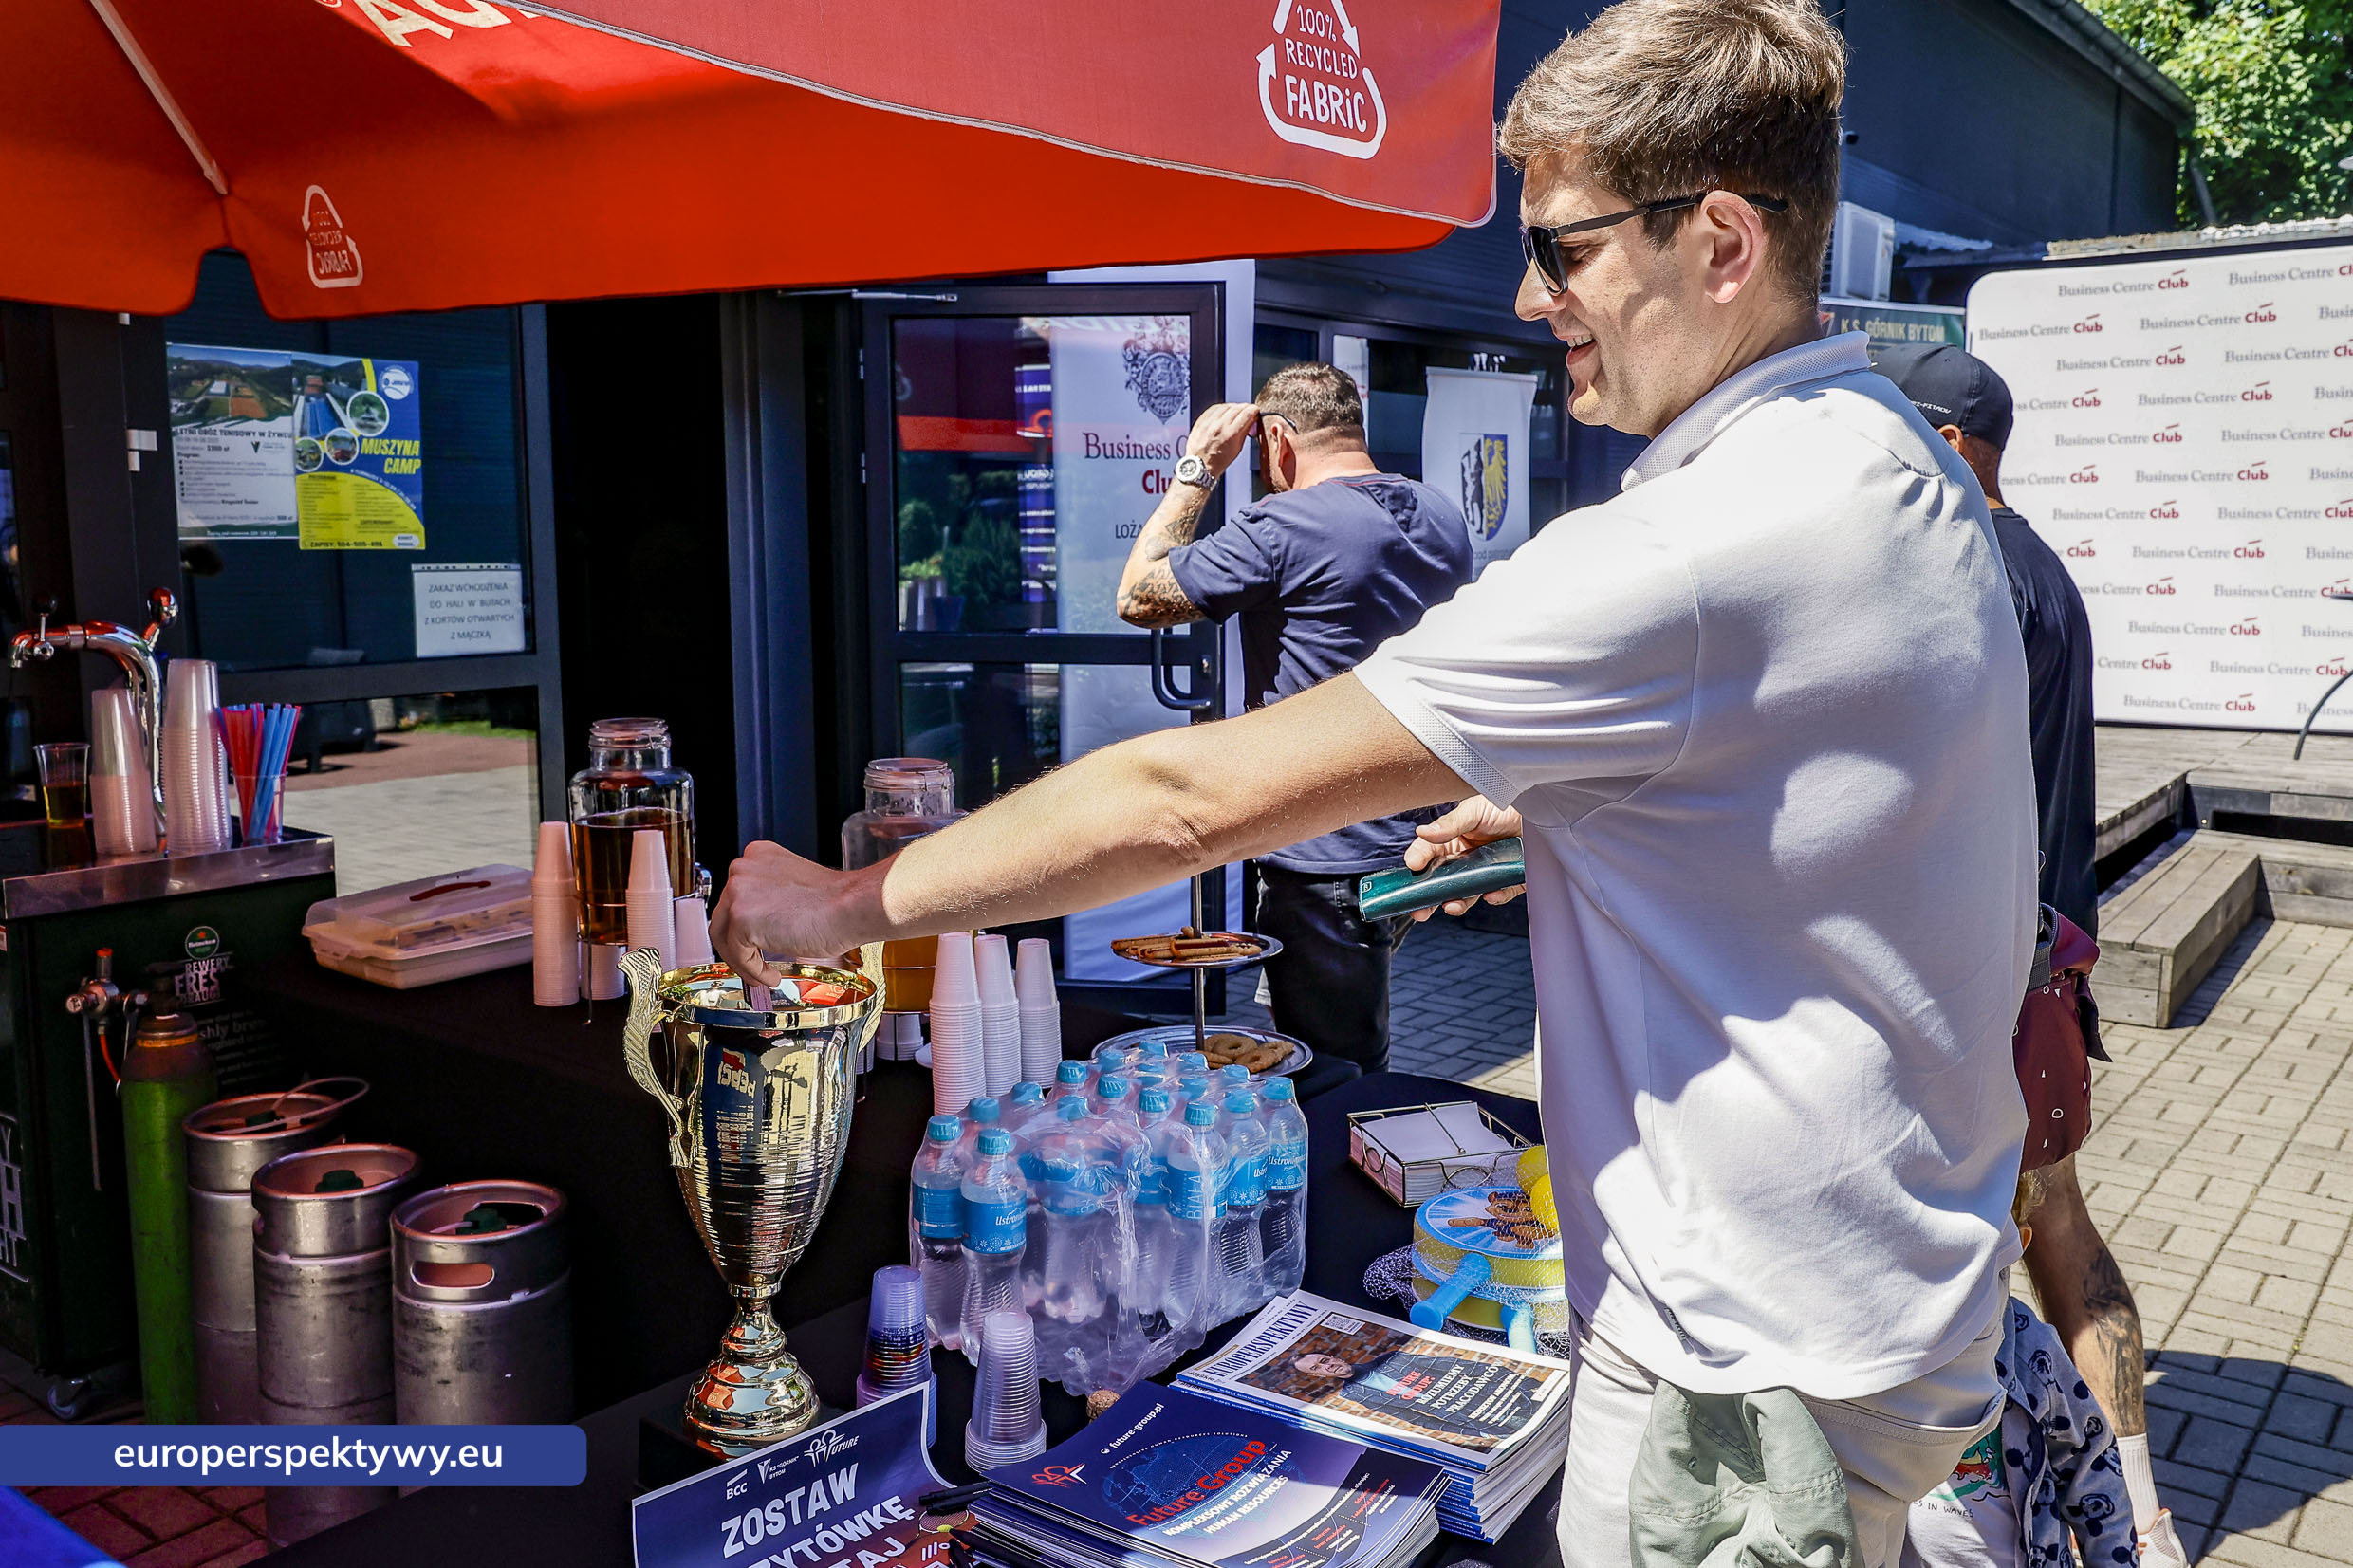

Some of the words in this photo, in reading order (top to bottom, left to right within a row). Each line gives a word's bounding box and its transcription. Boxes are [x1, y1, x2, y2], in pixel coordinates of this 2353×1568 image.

[1297, 4, 1337, 42] 100%
[1285, 38, 1358, 80] RECYCLED
[2229, 272, 2286, 286] Business
[2288, 267, 2334, 281] Centre
[2339, 265, 2353, 276] Cl
[2058, 285, 2109, 297] Business
[2112, 280, 2155, 294] Centre
[2158, 277, 2189, 289] Club
[2140, 318, 2196, 330] Business
[2198, 314, 2241, 327] Centre
[2245, 311, 2277, 323] Club
[2319, 305, 2353, 320] Busin
[1908, 323, 1945, 342] BYTOM
[1979, 328, 2028, 341] Business
[2029, 323, 2071, 338] Centre
[2073, 323, 2103, 333] Club
[2225, 350, 2281, 363] Business
[2283, 347, 2329, 360] Centre
[2334, 345, 2353, 358] Clu
[2056, 359, 2108, 371] Business
[2110, 356, 2152, 369] Centre
[2155, 355, 2186, 366] Club
[2138, 394, 2193, 406] Business
[2195, 391, 2237, 404] Centre
[2241, 390, 2273, 402] Club
[2314, 386, 2353, 400] Busin
[2029, 397, 2069, 411] Centre
[2072, 397, 2102, 409] Club
[2055, 434, 2105, 447] Business
[2107, 432, 2150, 445] Centre
[2153, 432, 2183, 443] Club
[2221, 430, 2277, 442] Business
[2279, 427, 2325, 441] Centre
[2329, 427, 2353, 439] Clu
[361, 438, 420, 456] MUSZYNA
[1083, 432, 1171, 460] Business
[384, 457, 422, 475] CAMP
[2309, 468, 2353, 481] Busin
[1142, 469, 1173, 494] Clu
[2001, 474, 2026, 486] ness
[2027, 472, 2067, 486] Centre
[2070, 472, 2099, 484] Club
[2135, 470, 2189, 483] Business
[2191, 469, 2233, 482] Centre
[2237, 470, 2269, 481] Club
[2052, 508, 2103, 521] Business
[2104, 507, 2146, 520] Centre
[2149, 508, 2179, 519] Club
[2217, 507, 2274, 520] Business
[2275, 507, 2321, 520] Centre
[2066, 546, 2096, 558] Club
[2133, 546, 2186, 559] Business
[2187, 546, 2230, 559] Centre
[2233, 547, 2265, 559] Club
[428, 583, 454, 593] ZAKAZ
[2102, 582, 2142, 596] Centre
[2146, 584, 2177, 596] Club
[2214, 584, 2270, 598] Business
[2271, 584, 2316, 598] Centre
[430, 600, 442, 608] DO
[480, 599, 510, 608] BUTACH
[467, 614, 515, 623] OTWARTYCH
[2128, 621, 2180, 635] Business
[2183, 623, 2226, 636] Centre
[2230, 624, 2261, 636] Club
[2098, 657, 2139, 670] Centre
[2142, 659, 2172, 670] Club
[2210, 660, 2265, 673] Business
[2267, 662, 2311, 675] Centre
[2316, 665, 2348, 676] Club
[2123, 695, 2177, 709] Business
[2178, 697, 2221, 711] Centre
[2225, 701, 2255, 712] Club
[185, 957, 230, 974] REWERY
[175, 968, 220, 997] FRES
[1202, 1301, 1319, 1378] EUROPERSPEKTYWY
[1415, 1364, 1465, 1405] ROZUMIEMY
[1430, 1374, 1473, 1410] POTRZEBY
[1109, 1403, 1165, 1448] future-group.pl
[769, 1468, 786, 1481] BYTOM
[1125, 1490, 1206, 1526] Future
[1197, 1440, 1267, 1490] Group
[726, 1482, 748, 1501] BCC
[1162, 1497, 1234, 1537] KOMPLEKSOWE
[1233, 1449, 1292, 1503] ROZWIĄZANIA
[721, 1463, 860, 1559] ZOSTAW
[1203, 1511, 1244, 1534] HUMAN
[1241, 1474, 1289, 1516] RESOURCES
[1927, 1503, 1938, 1512] IN
[1943, 1506, 1974, 1518] WAVES
[749, 1495, 916, 1568] YTÓWKĘ
